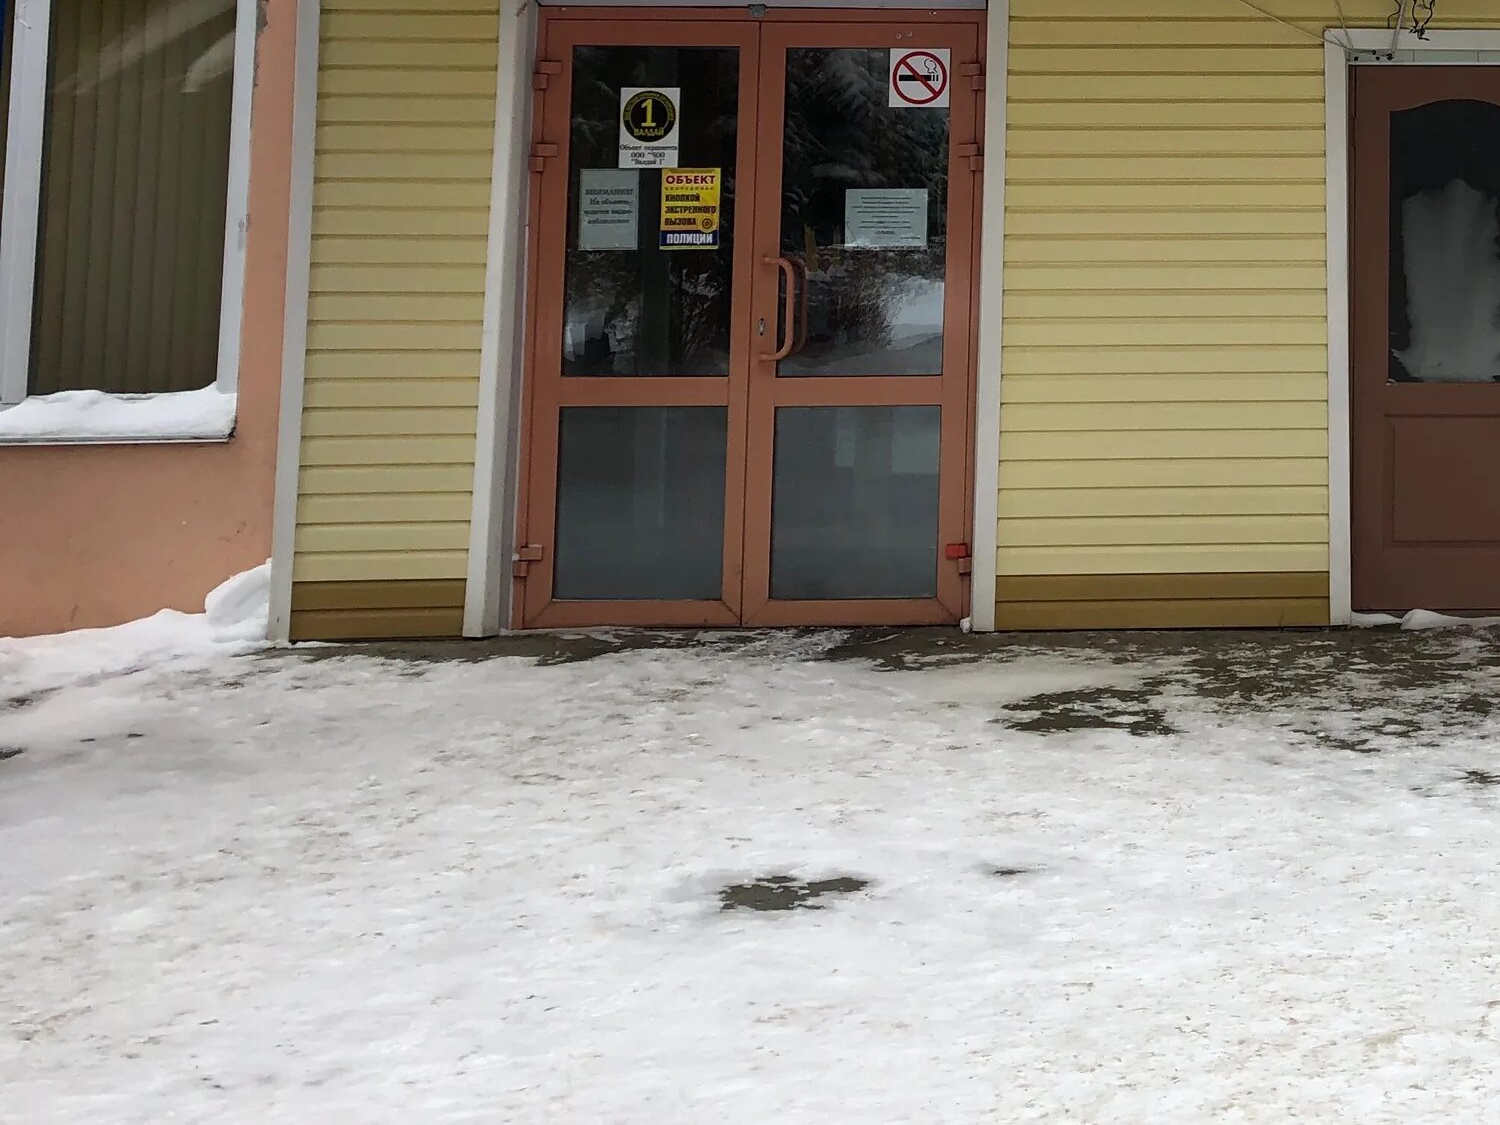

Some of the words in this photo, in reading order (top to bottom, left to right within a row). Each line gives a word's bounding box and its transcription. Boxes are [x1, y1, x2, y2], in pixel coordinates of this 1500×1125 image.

[640, 98, 657, 127] 1
[665, 175, 716, 185] ОБЪЕКТ
[664, 192, 701, 203] КНОПКОЙ
[664, 205, 717, 214] ЭКСТРЕННОГО
[664, 217, 697, 226] ВЫЗОВА
[666, 233, 713, 245] ПОЛИЦИИ
